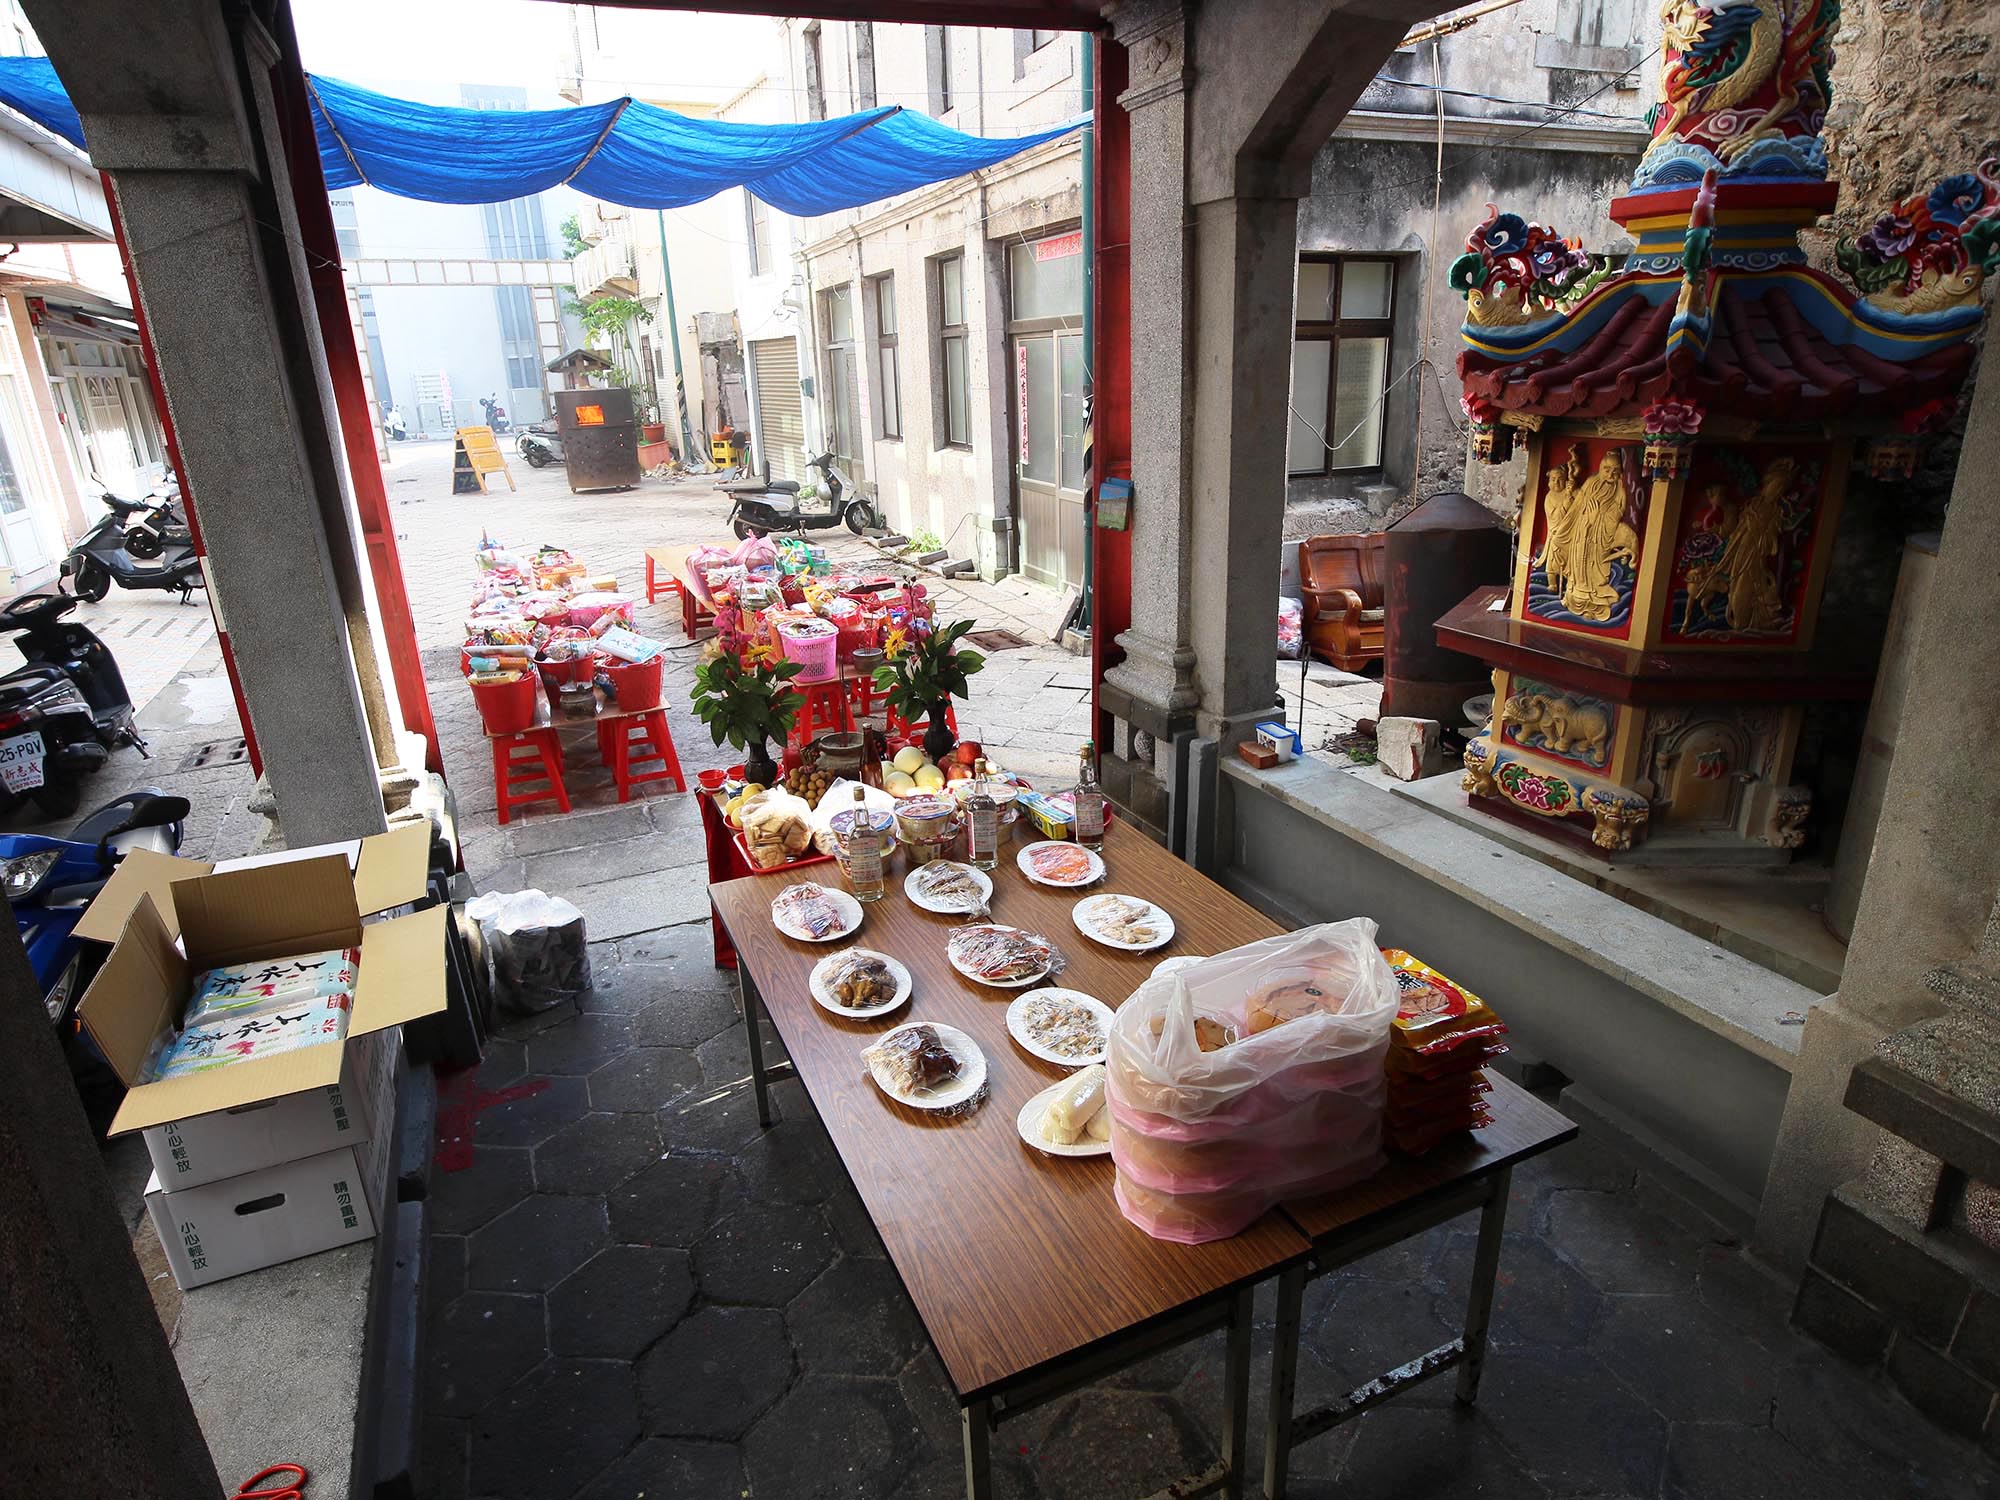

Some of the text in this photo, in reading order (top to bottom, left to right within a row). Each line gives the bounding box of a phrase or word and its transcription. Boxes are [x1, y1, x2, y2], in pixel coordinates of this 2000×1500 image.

[164, 1123, 192, 1173] 小心輕放
[333, 1180, 359, 1229] 請勿重壓
[180, 1221, 209, 1270] 小心輕放
